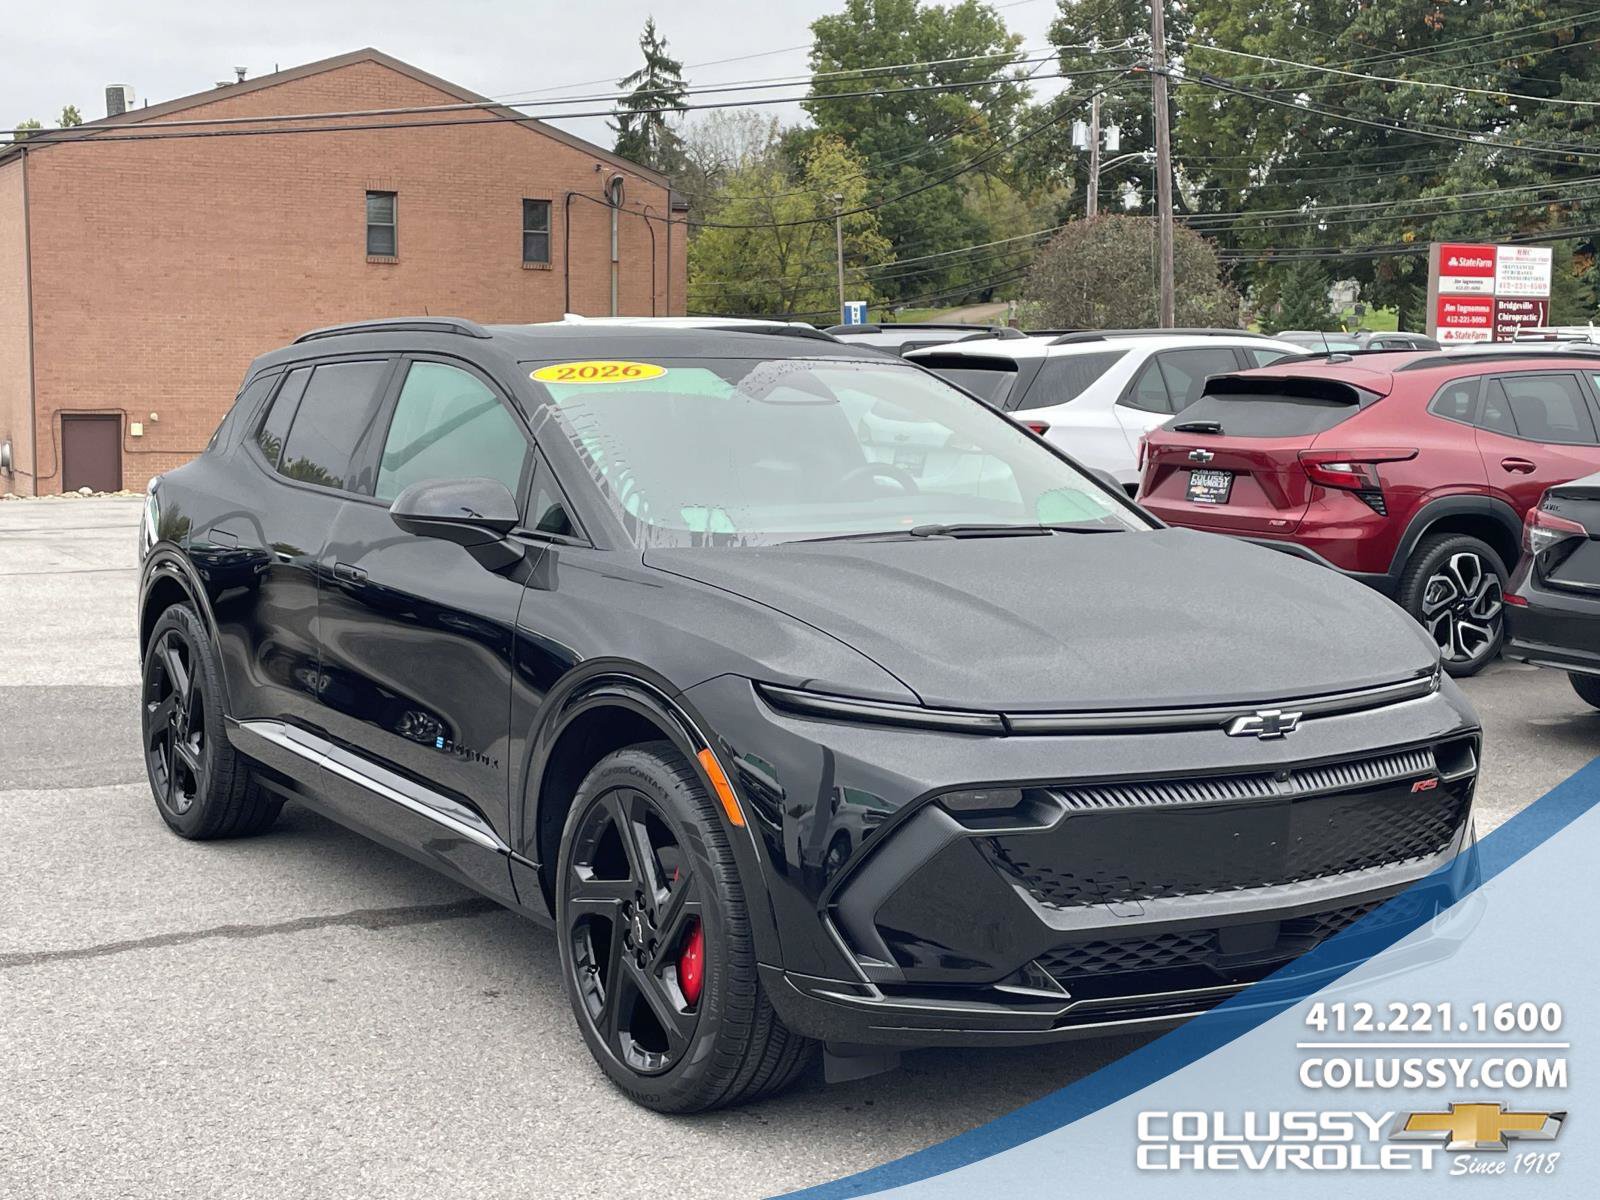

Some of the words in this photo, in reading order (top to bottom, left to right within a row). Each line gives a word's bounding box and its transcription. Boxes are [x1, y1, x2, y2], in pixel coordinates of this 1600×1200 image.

[1444, 303, 1456, 312] Jim
[1498, 301, 1533, 311] Bridgeville
[1498, 312, 1539, 322] Chiropractic
[557, 364, 642, 380] 2026
[1411, 777, 1439, 793] RS
